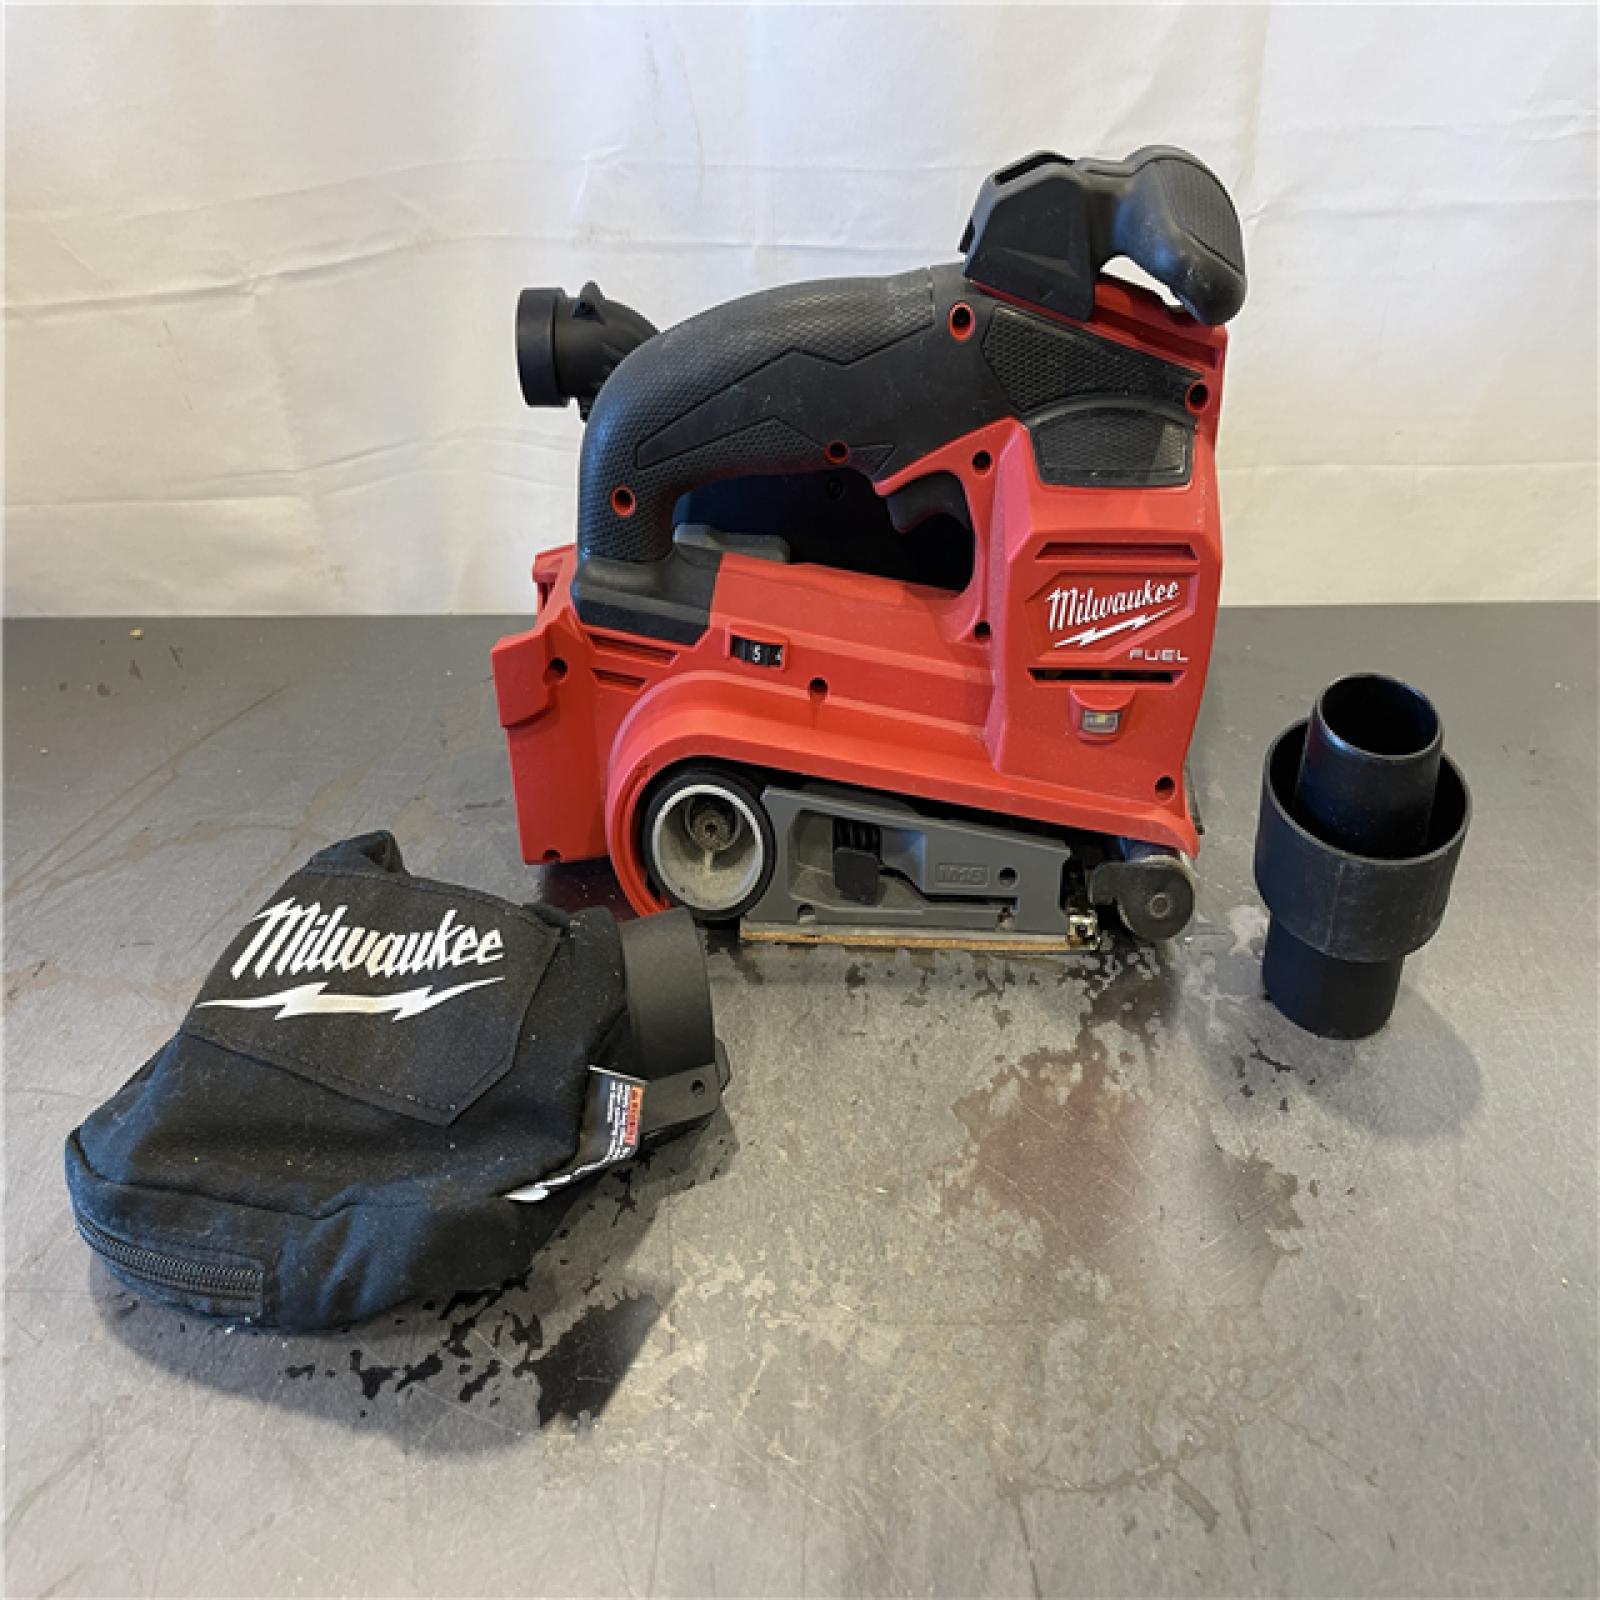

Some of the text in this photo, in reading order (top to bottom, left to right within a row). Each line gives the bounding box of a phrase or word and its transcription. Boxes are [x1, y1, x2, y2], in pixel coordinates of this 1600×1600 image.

[1046, 579, 1180, 632] Milwaukee
[752, 644, 761, 663] 5
[1129, 647, 1188, 661] FUEL
[230, 897, 504, 980] Milwaukee
